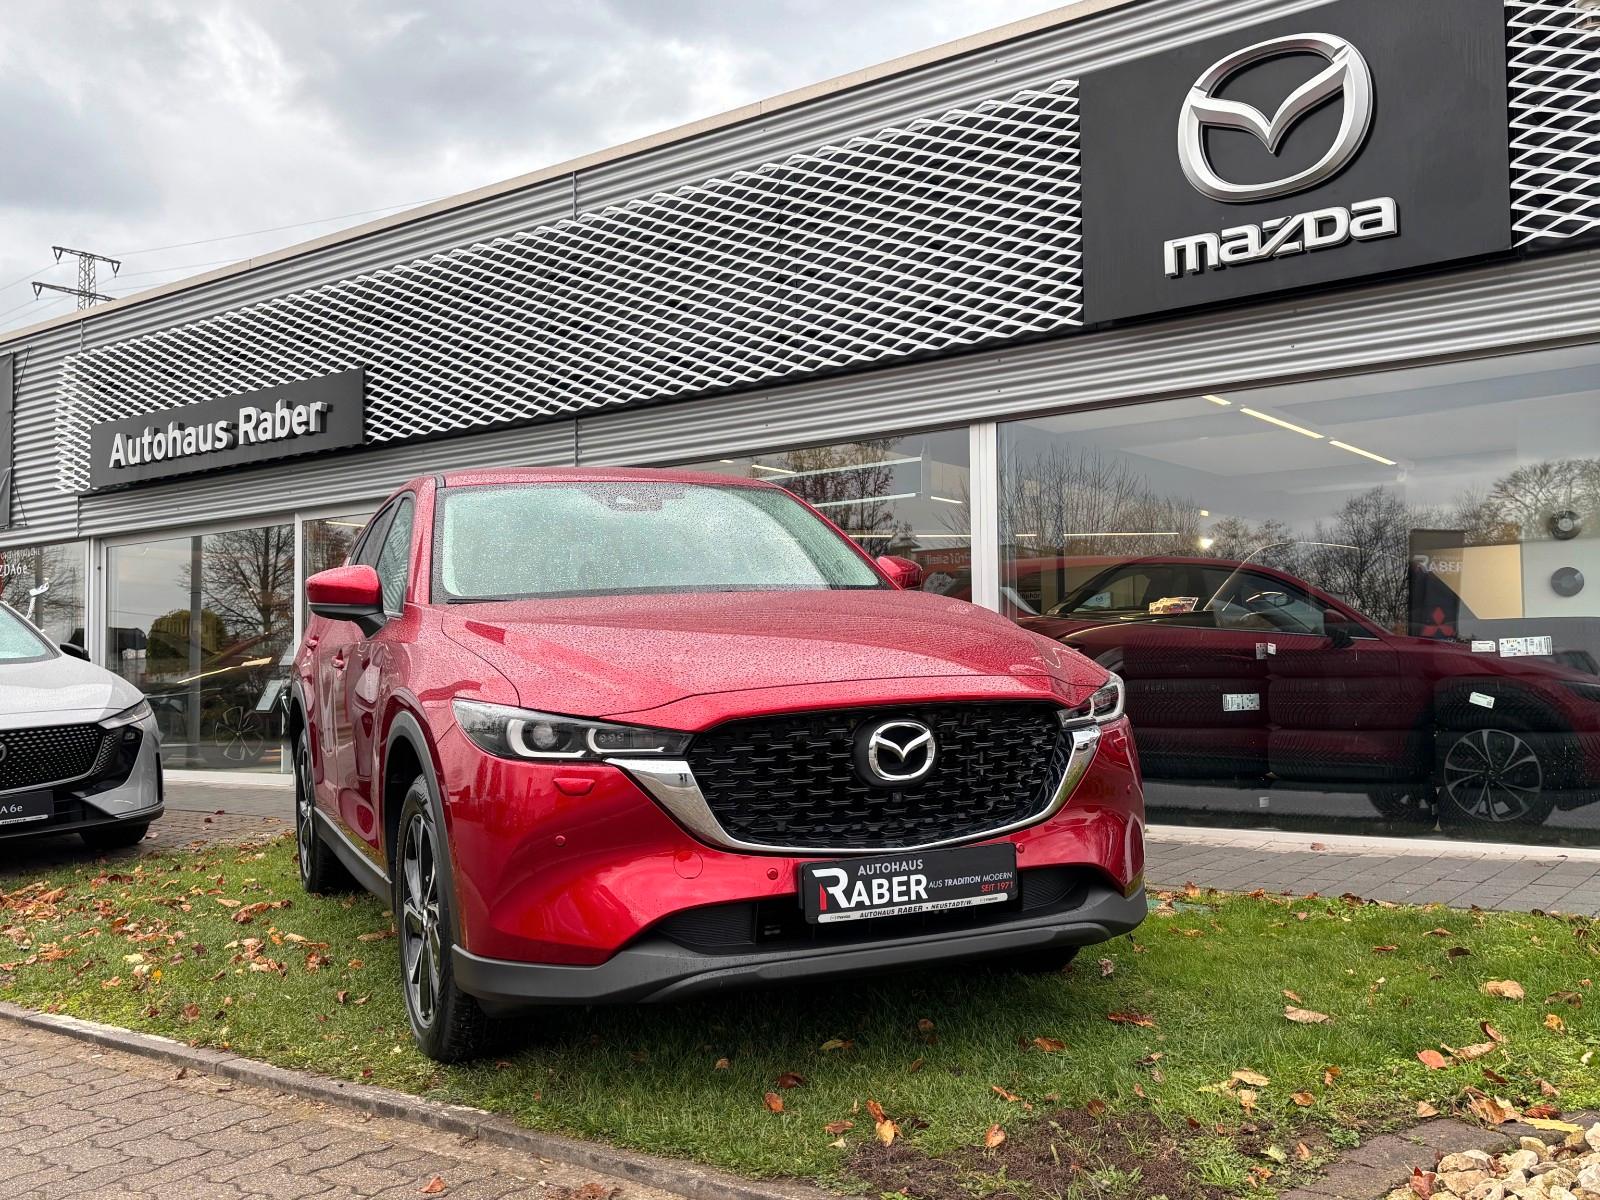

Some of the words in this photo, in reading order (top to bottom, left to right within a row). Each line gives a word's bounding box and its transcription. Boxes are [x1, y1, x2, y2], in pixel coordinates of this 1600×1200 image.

[109, 420, 231, 468] Autohaus
[238, 400, 326, 445] Raber
[10, 804, 23, 813] 6e
[858, 859, 924, 876] AUTOHAUS
[812, 867, 929, 911] RABER
[928, 881, 943, 889] AUS
[944, 875, 981, 887] TRADITION
[982, 872, 1013, 882] MODERN
[981, 883, 995, 892] SEIT
[997, 881, 1013, 891] 1971
[860, 908, 895, 918] AUTOHAUS
[897, 905, 924, 915] RABER
